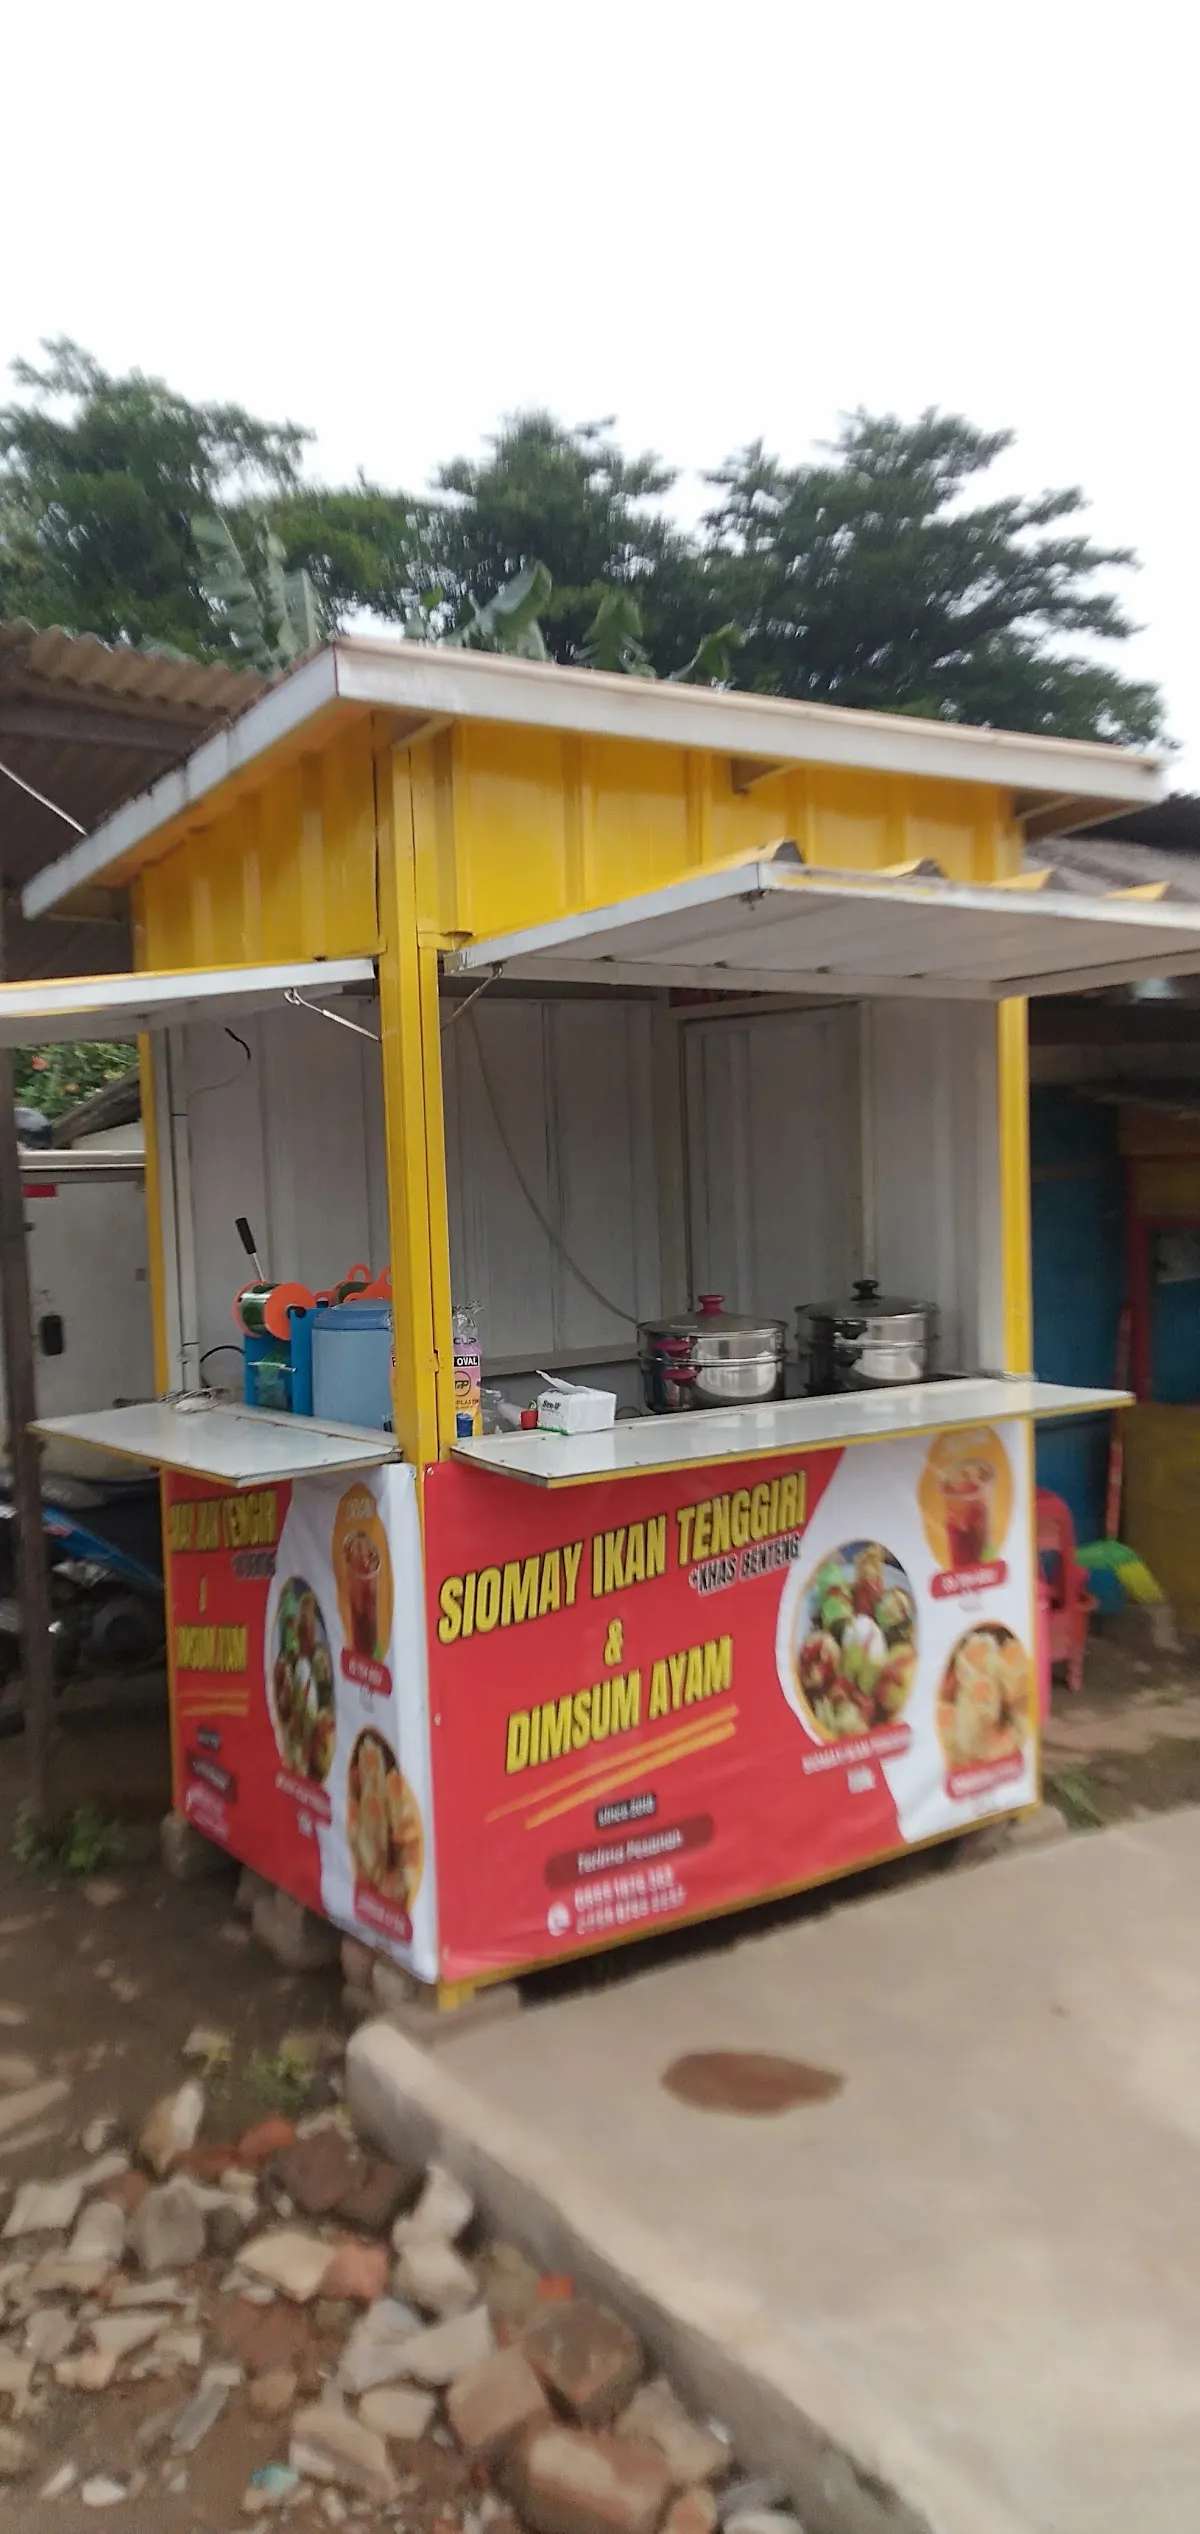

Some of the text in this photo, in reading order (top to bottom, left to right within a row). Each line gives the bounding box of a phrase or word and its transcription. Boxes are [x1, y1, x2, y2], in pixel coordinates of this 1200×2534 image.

[456, 1357, 478, 1366] OVAL
[438, 1468, 808, 1645] SIOMAY IKAN TENGGIRI
[602, 1616, 626, 1667] &
[505, 1633, 734, 1776] DIMSUM AYAM
